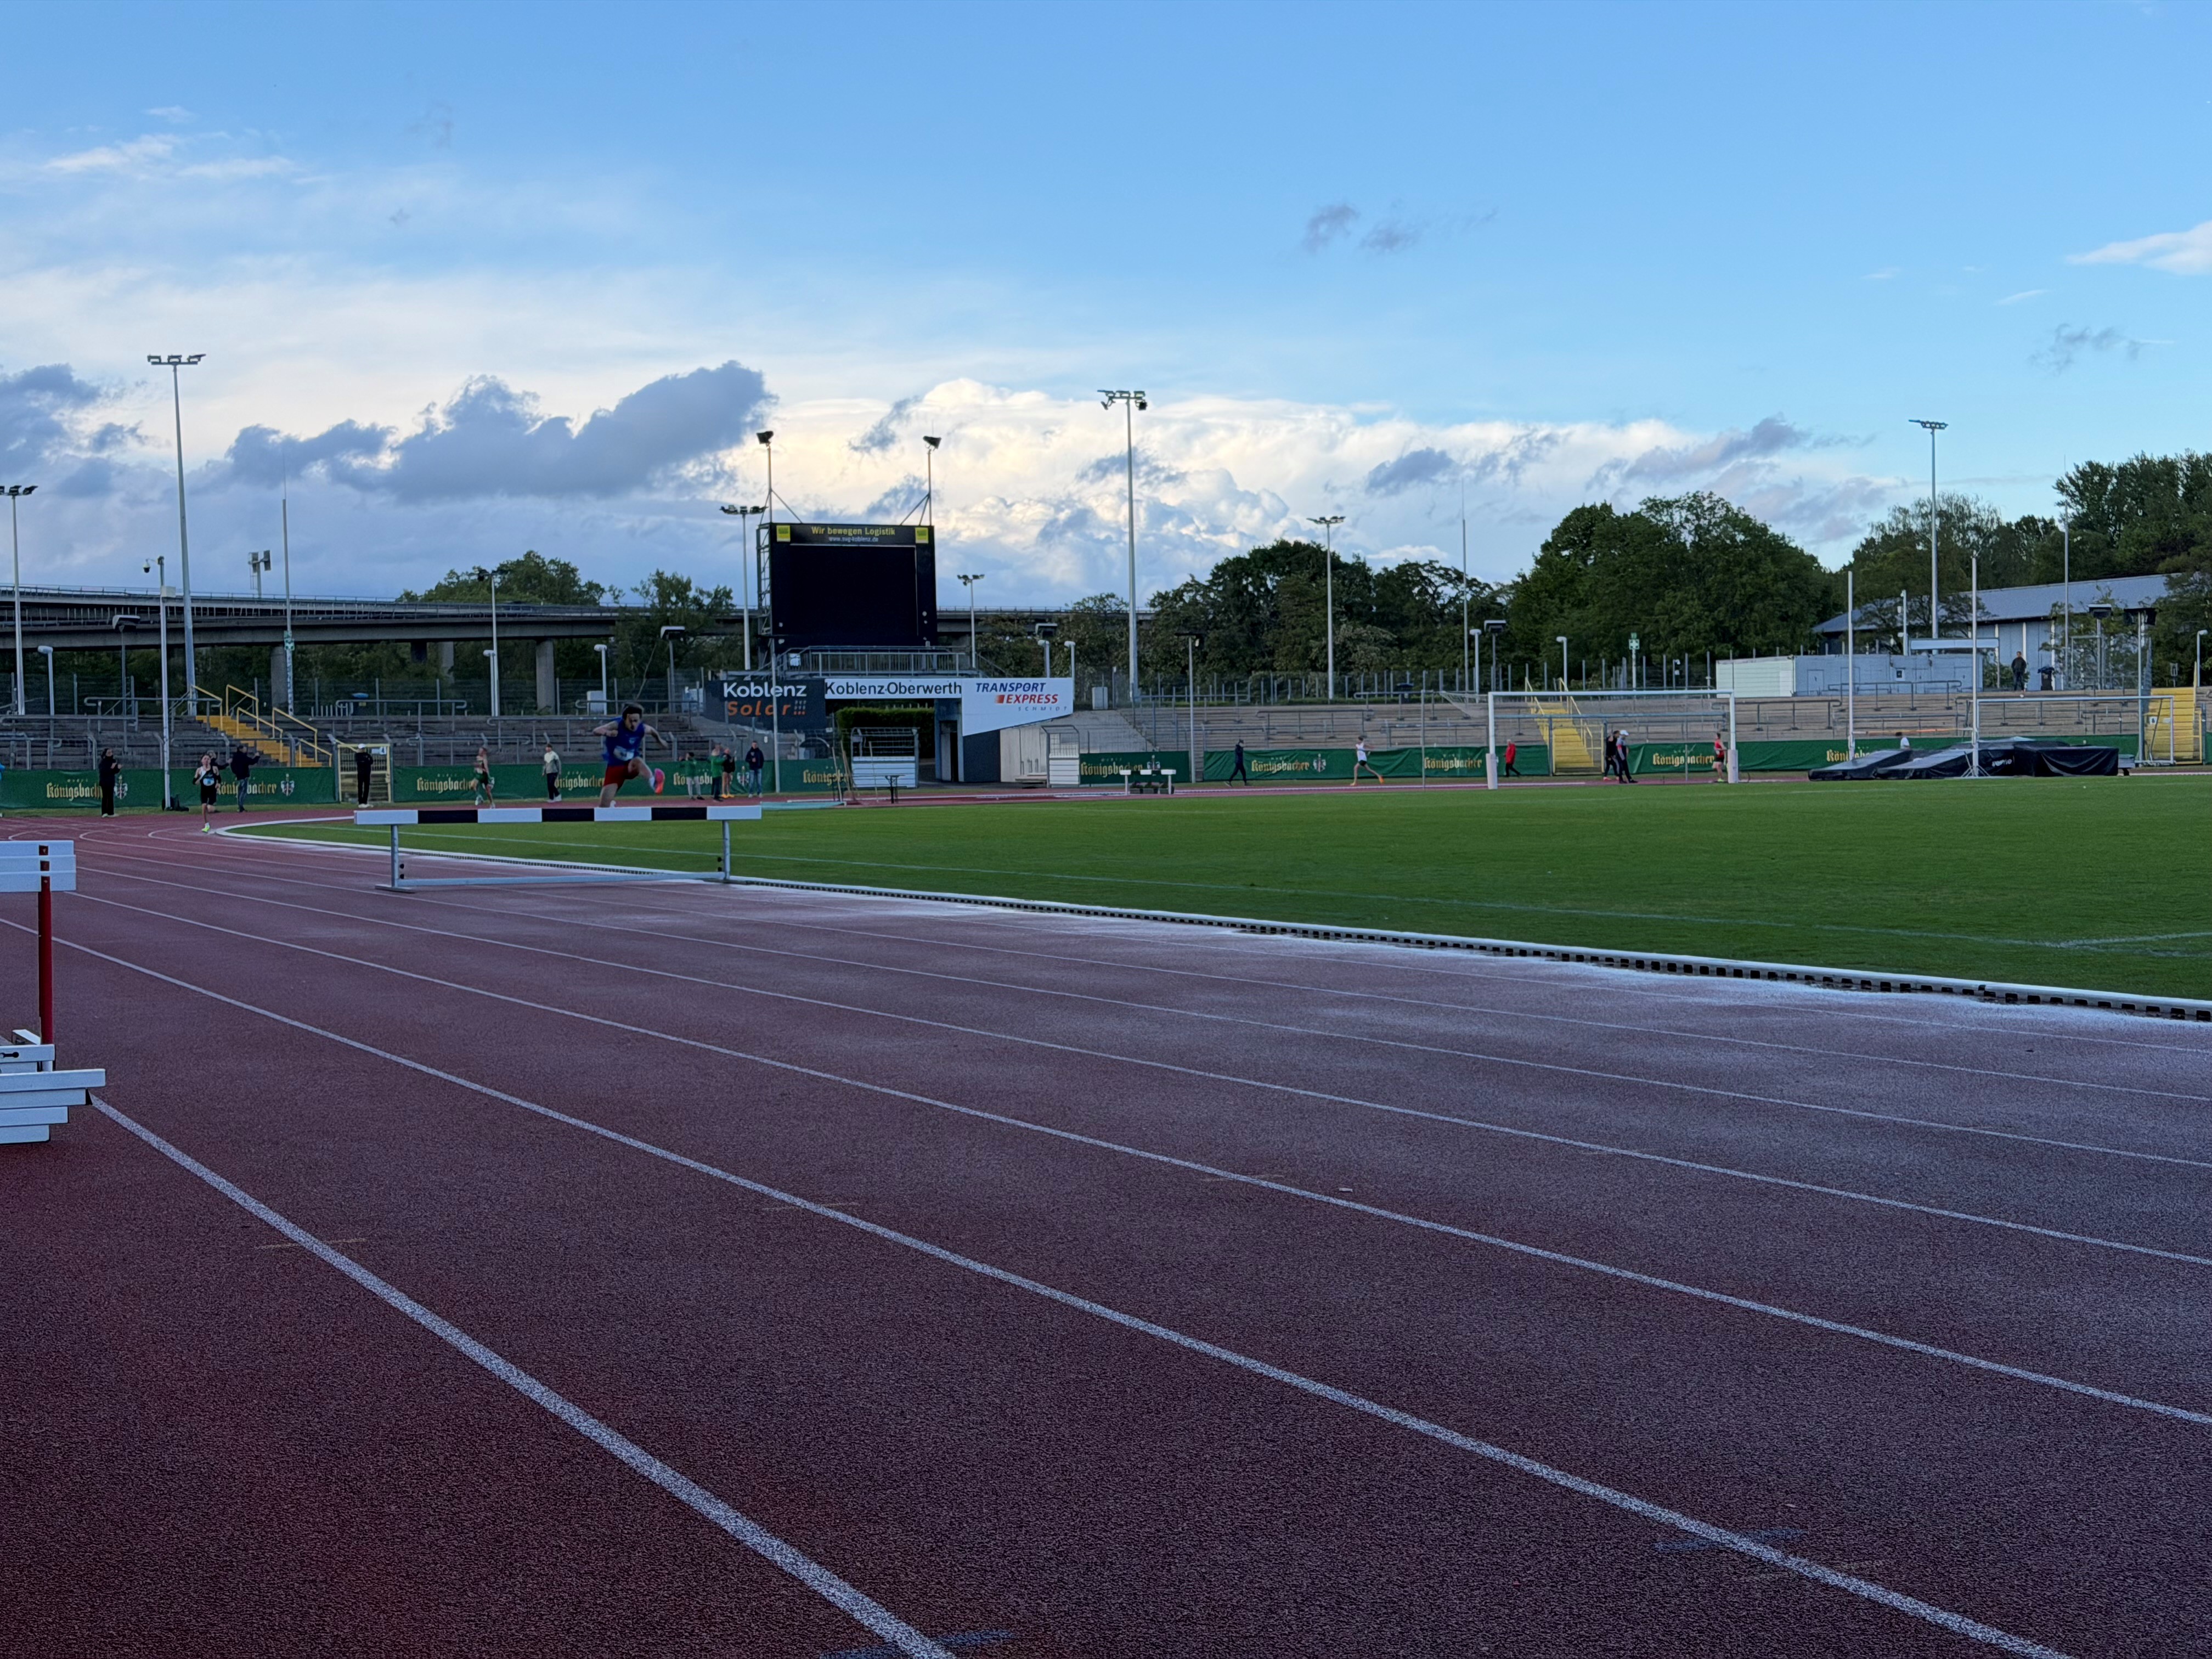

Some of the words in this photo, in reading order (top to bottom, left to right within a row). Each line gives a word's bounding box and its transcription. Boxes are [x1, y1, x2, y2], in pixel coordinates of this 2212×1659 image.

[812, 526, 825, 535] Wir
[827, 527, 862, 537] bewegen
[865, 527, 895, 537] Logistik
[724, 681, 807, 697] Koblenz
[976, 682, 1046, 692] TRANSPORT
[1006, 694, 1058, 704] EXPRESS
[1251, 759, 1310, 774] Königsbacher
[1424, 757, 1482, 771] Königsbacher
[216, 781, 277, 798] önibacher
[417, 777, 472, 794] Königsbach
[554, 775, 605, 791] önigsbache
[47, 782, 103, 802] Königsbach
